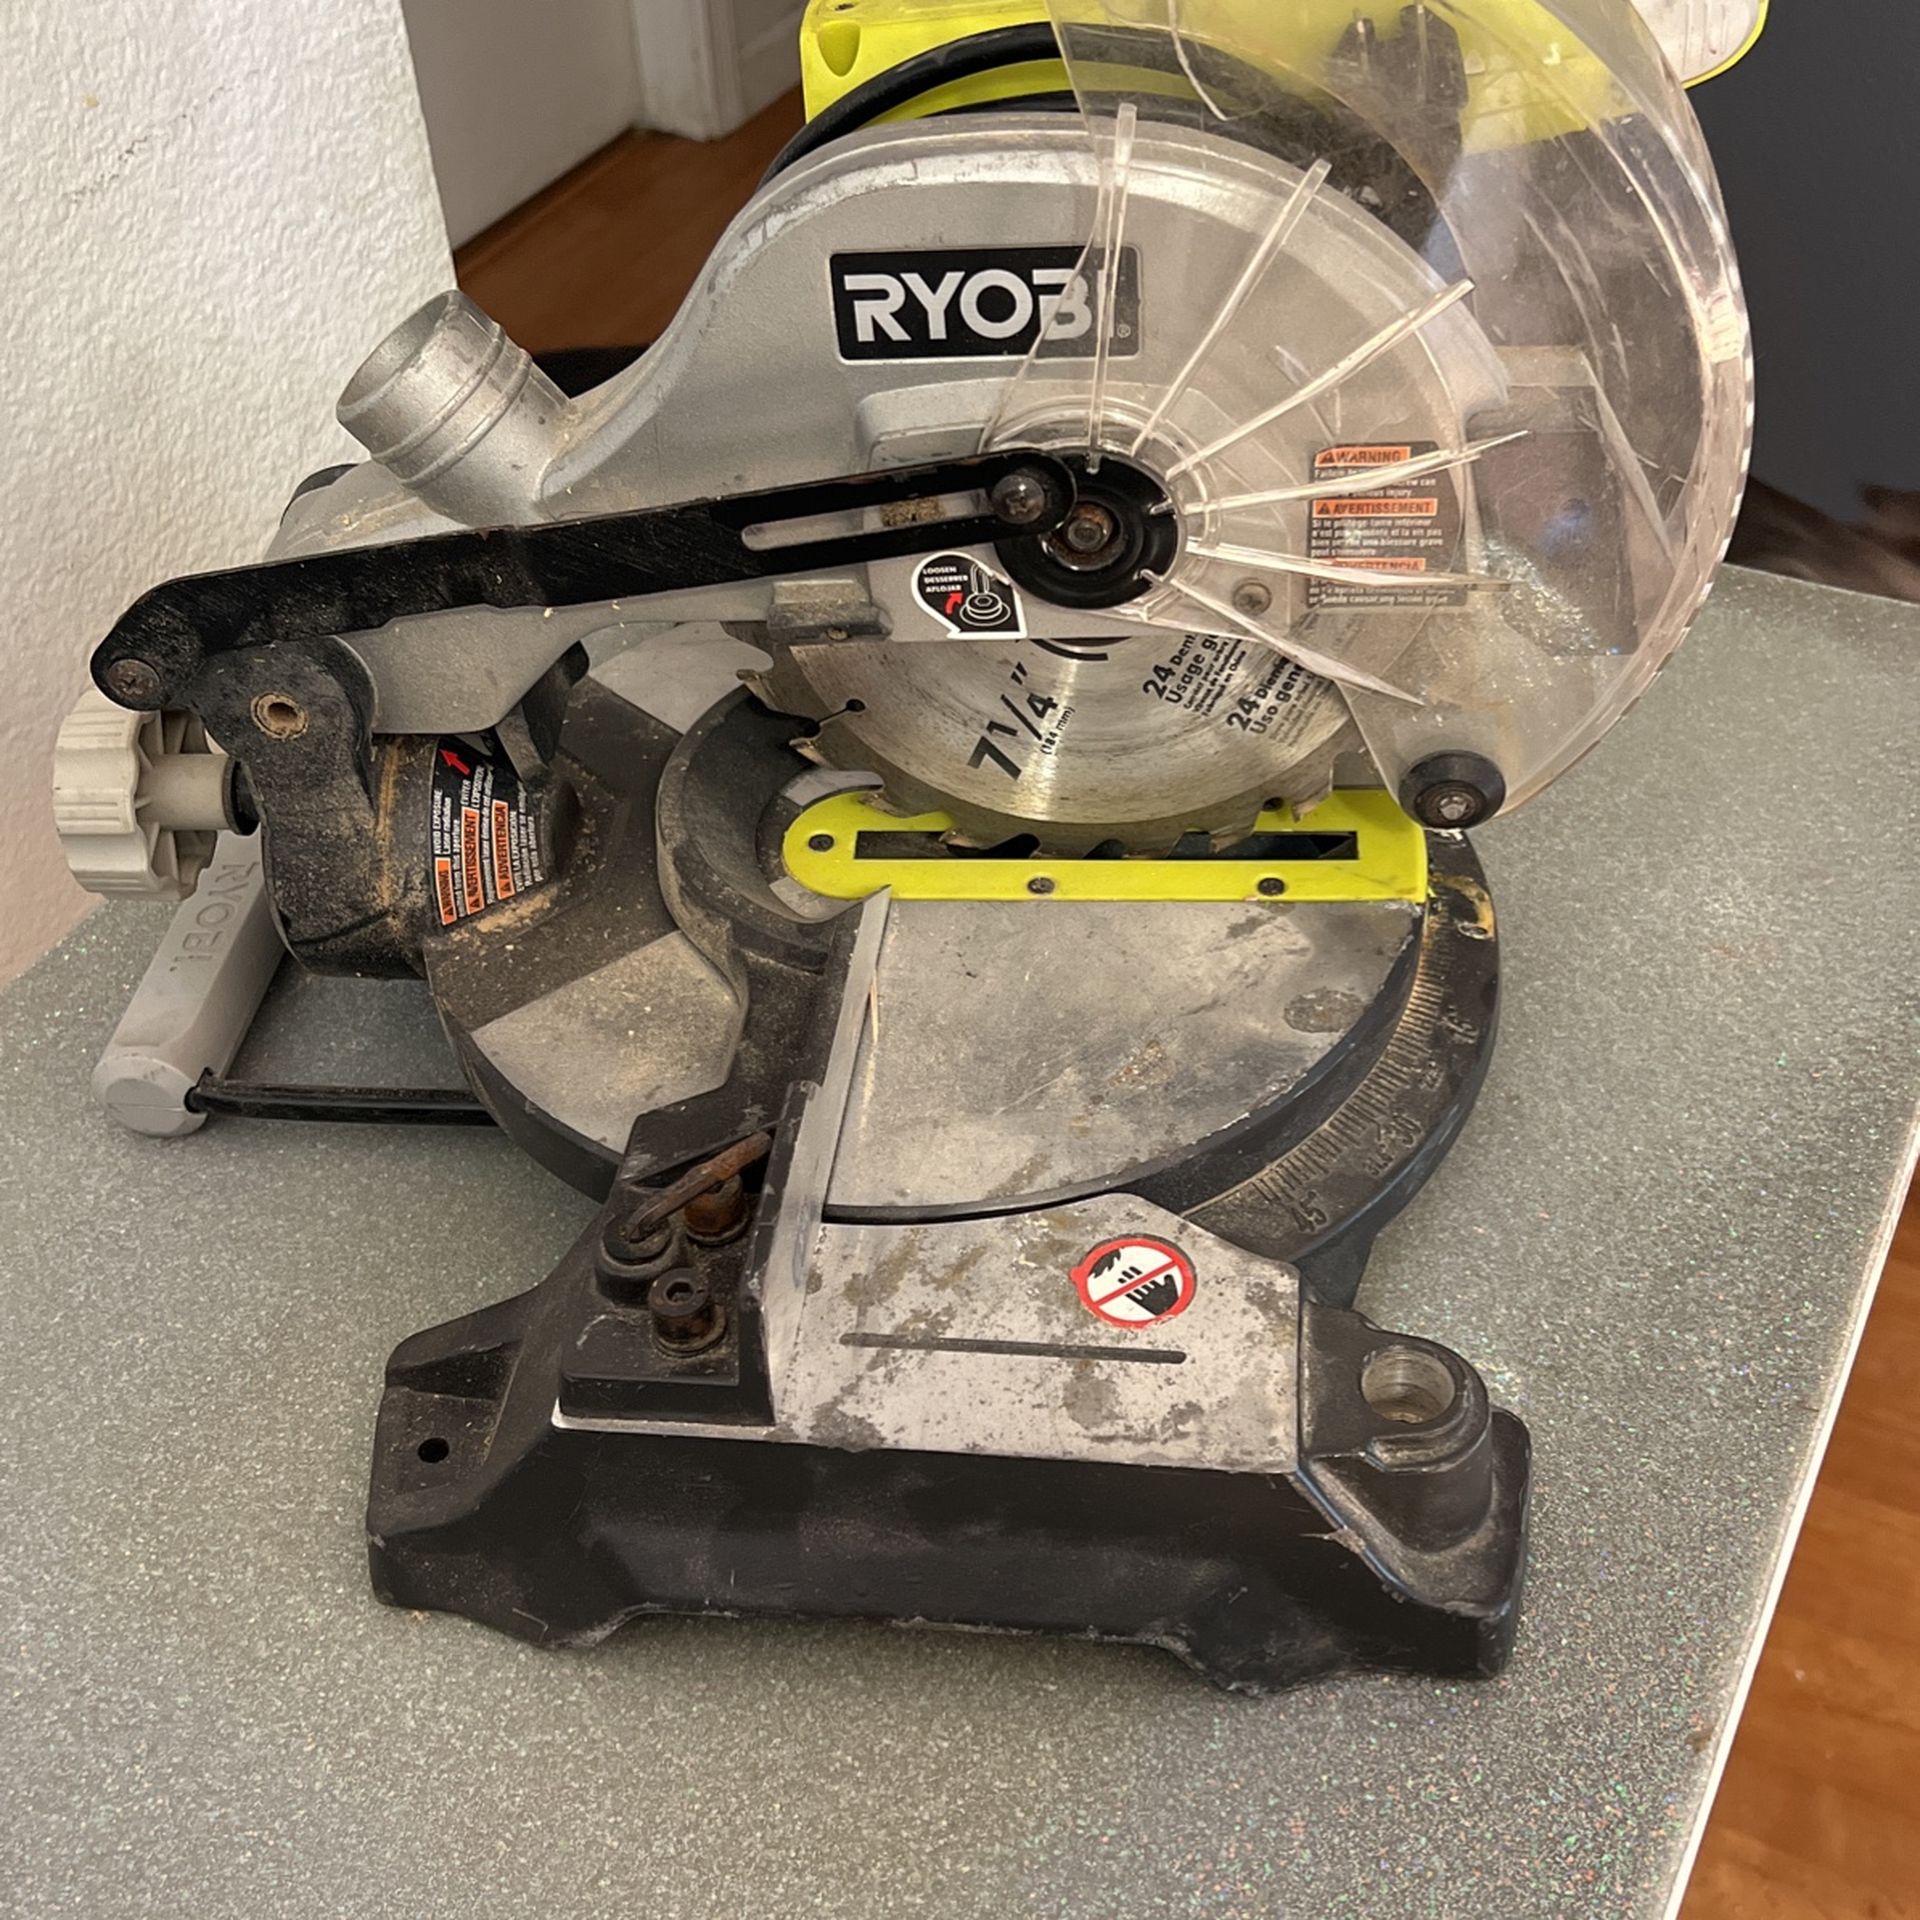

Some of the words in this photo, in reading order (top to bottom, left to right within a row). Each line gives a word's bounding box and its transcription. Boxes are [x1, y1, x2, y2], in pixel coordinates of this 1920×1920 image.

[844, 269, 1114, 342] RYOBI
[1337, 451, 1400, 463] WARNING
[1334, 503, 1430, 514] AVERTISSEMENT
[923, 566, 957, 575] LOOSEN
[925, 584, 962, 593] AFLOJAR
[1143, 664, 1175, 699] 24
[1170, 633, 1197, 665] Dent
[1166, 653, 1205, 704] Usage
[1227, 696, 1260, 731] 24
[1250, 705, 1279, 734] Uso
[495, 805, 509, 879] ADVERTENCIA
